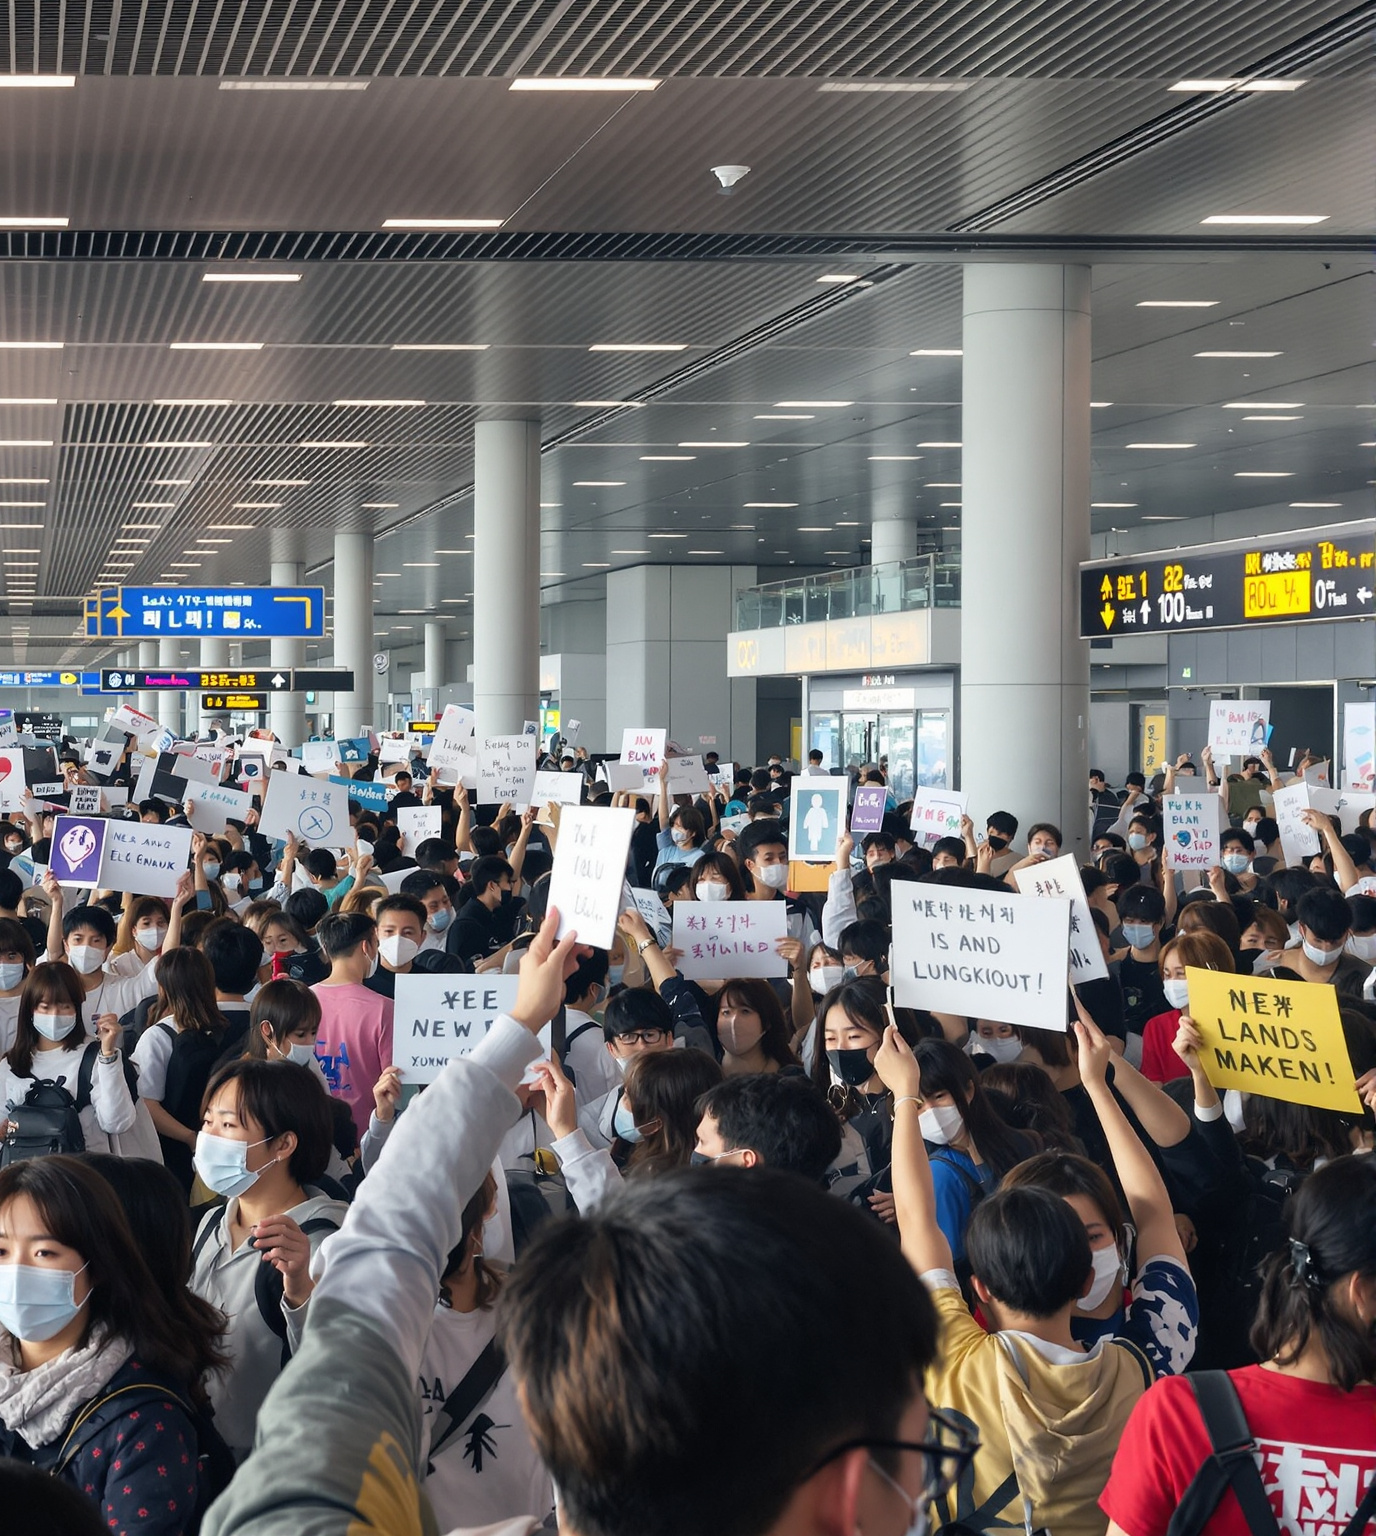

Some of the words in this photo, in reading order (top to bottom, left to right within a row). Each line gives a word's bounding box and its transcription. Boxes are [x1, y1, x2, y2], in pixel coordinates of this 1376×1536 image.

[931, 932, 949, 950] IS
[959, 934, 1001, 955] AND
[412, 1018, 472, 1037] NEW
[1218, 1018, 1317, 1052] LANDS
[1214, 1048, 1335, 1085] MAKEN!
